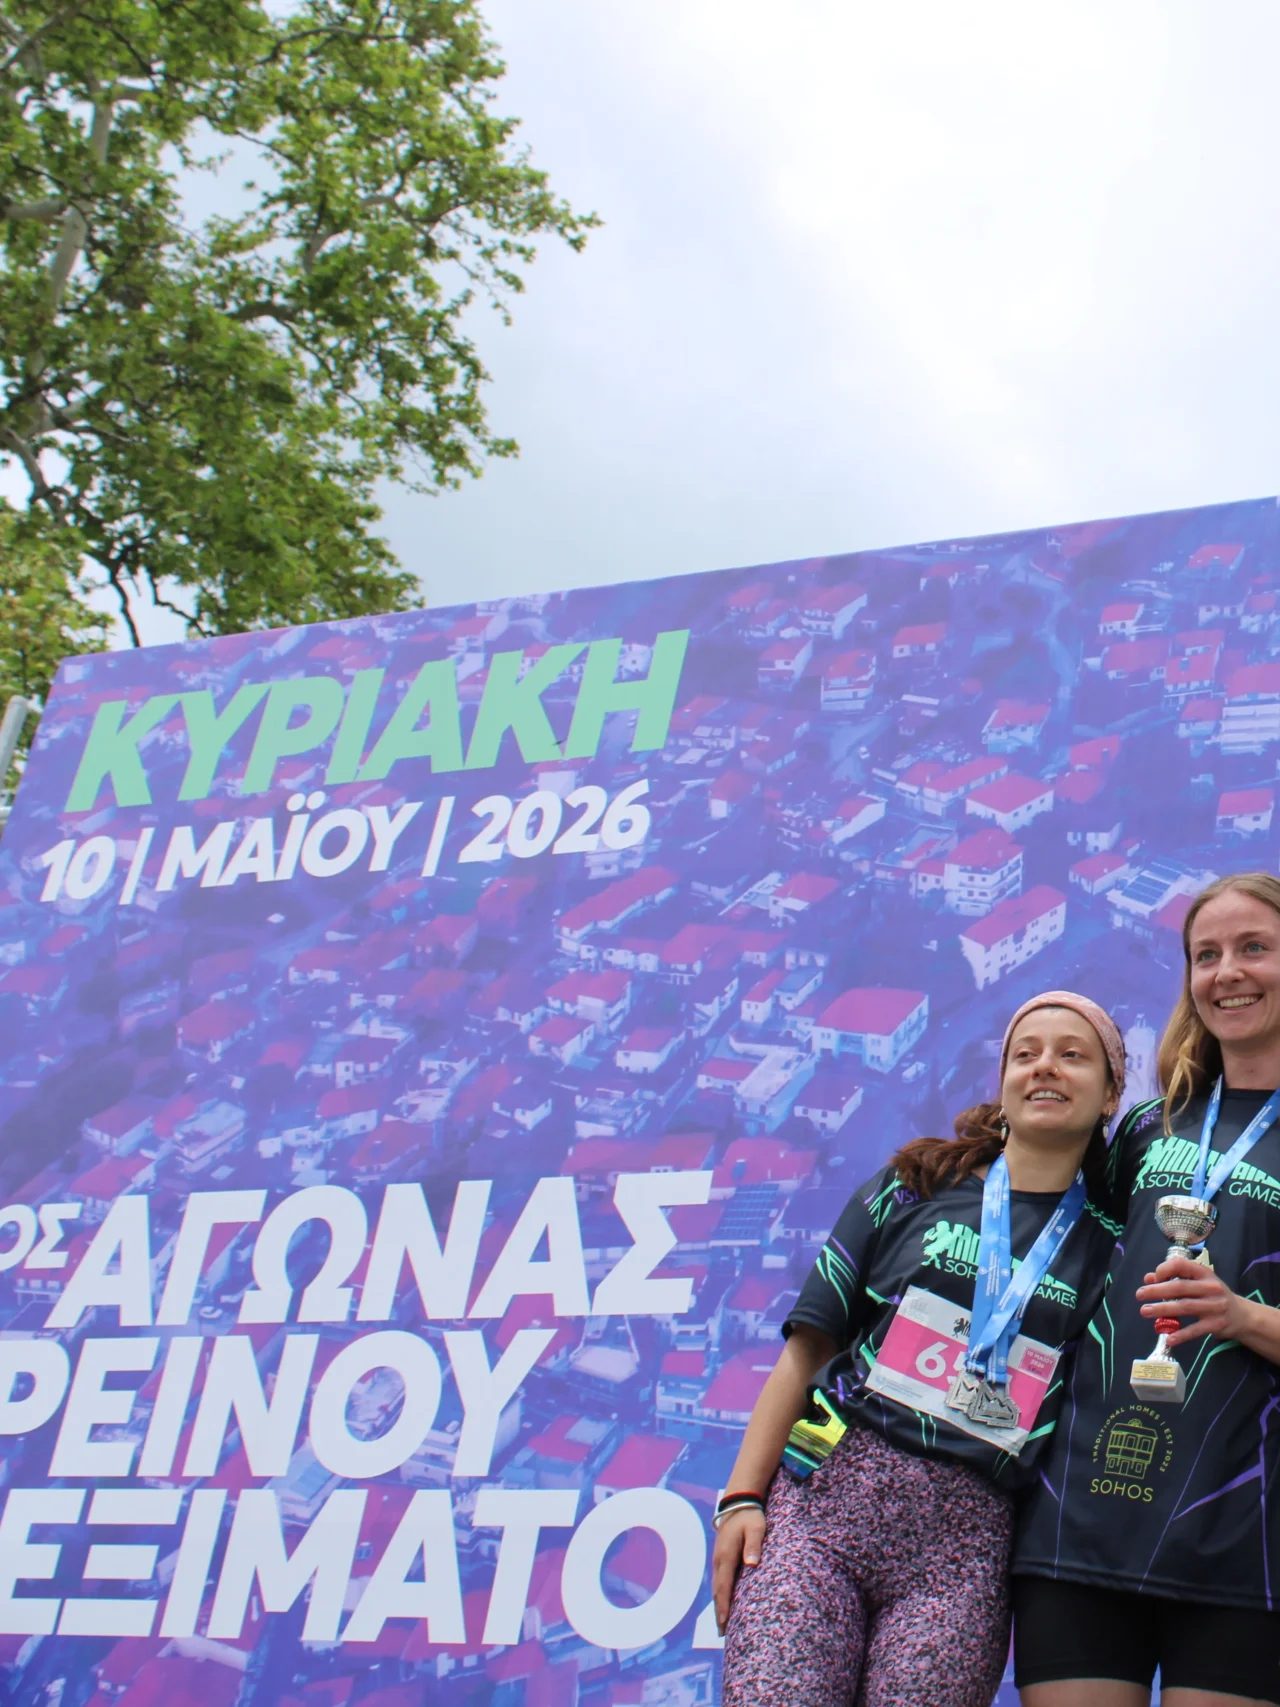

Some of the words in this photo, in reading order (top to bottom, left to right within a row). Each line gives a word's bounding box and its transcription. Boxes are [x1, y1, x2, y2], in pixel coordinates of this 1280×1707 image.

[63, 628, 691, 813] ΚΥΡΙΑΚΗ
[39, 835, 116, 903] 10
[155, 790, 425, 893] ΜΑΪΟΥ
[457, 778, 652, 864] 2026
[43, 1169, 714, 1329] ΑΓΩΝΑΣ
[1033, 1287, 1078, 1310] AMES
[1090, 1478, 1154, 1502] SOHOS
[1092, 1407, 1126, 1463] TRADITIONAL
[1129, 1404, 1161, 1421] HOMES
[1164, 1428, 1173, 1445] EST
[0, 1486, 735, 1650] ΕΞΙΜΑΤΟ
